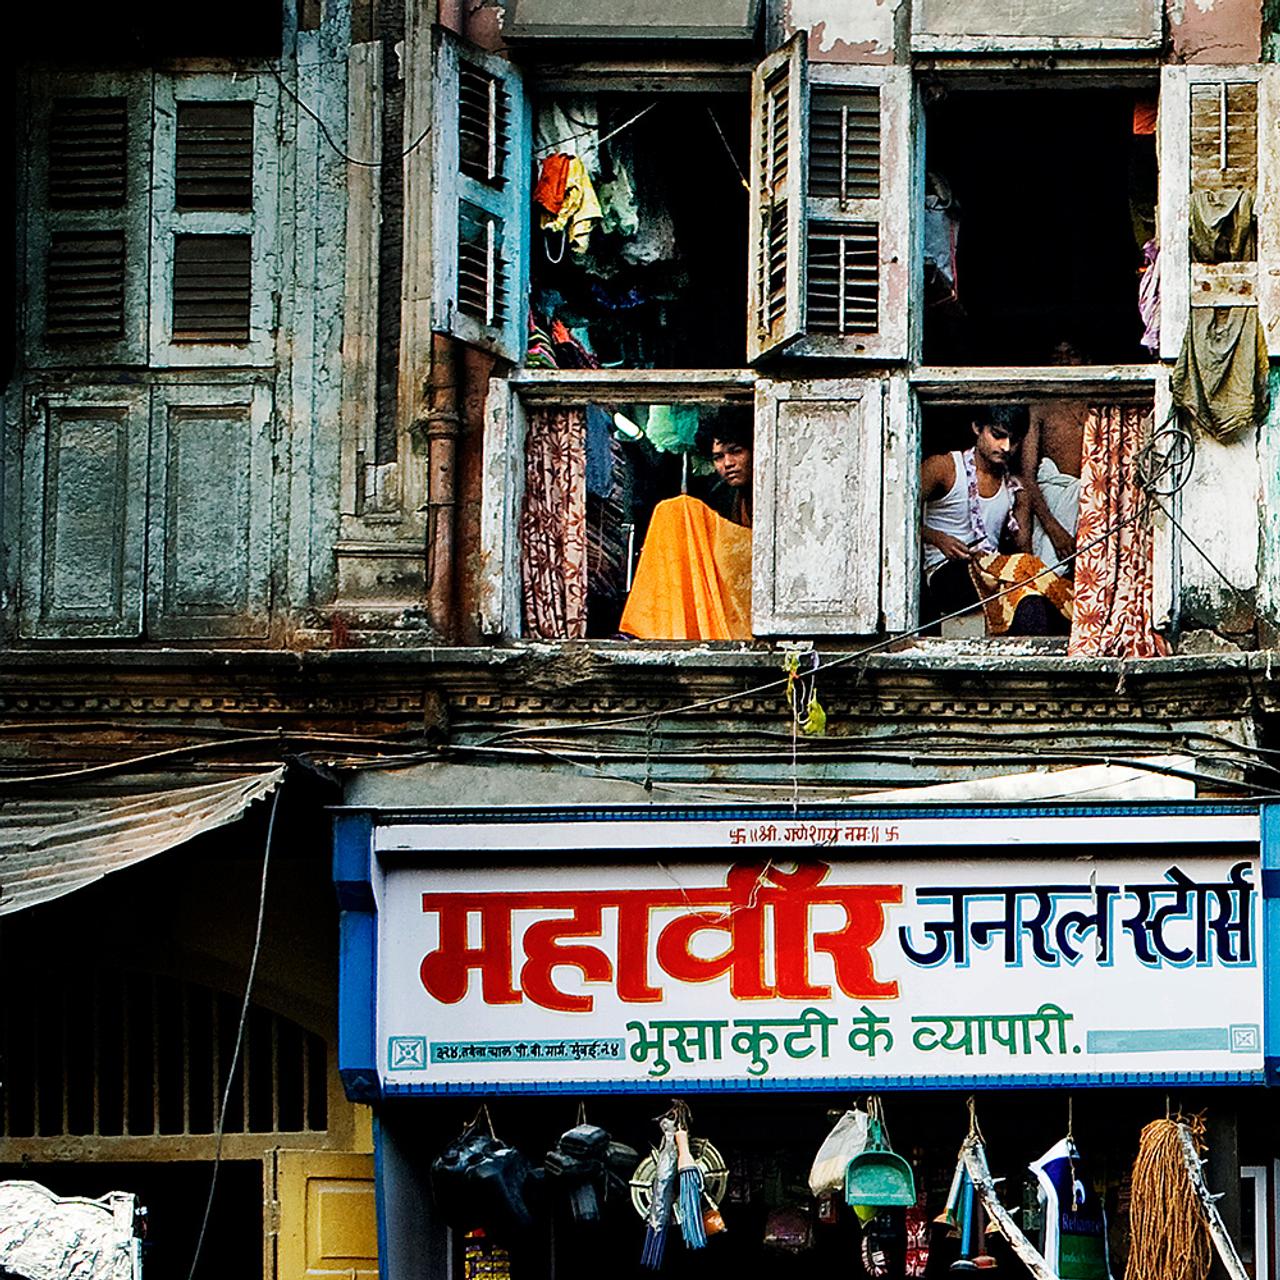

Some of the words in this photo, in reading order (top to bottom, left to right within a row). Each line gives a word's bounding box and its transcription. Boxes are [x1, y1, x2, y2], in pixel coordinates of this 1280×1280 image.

[420, 856, 904, 1014] महावीर
[899, 883, 1120, 967] जनरल
[1122, 861, 1258, 968] स्टोर्स
[848, 1005, 894, 1057] के
